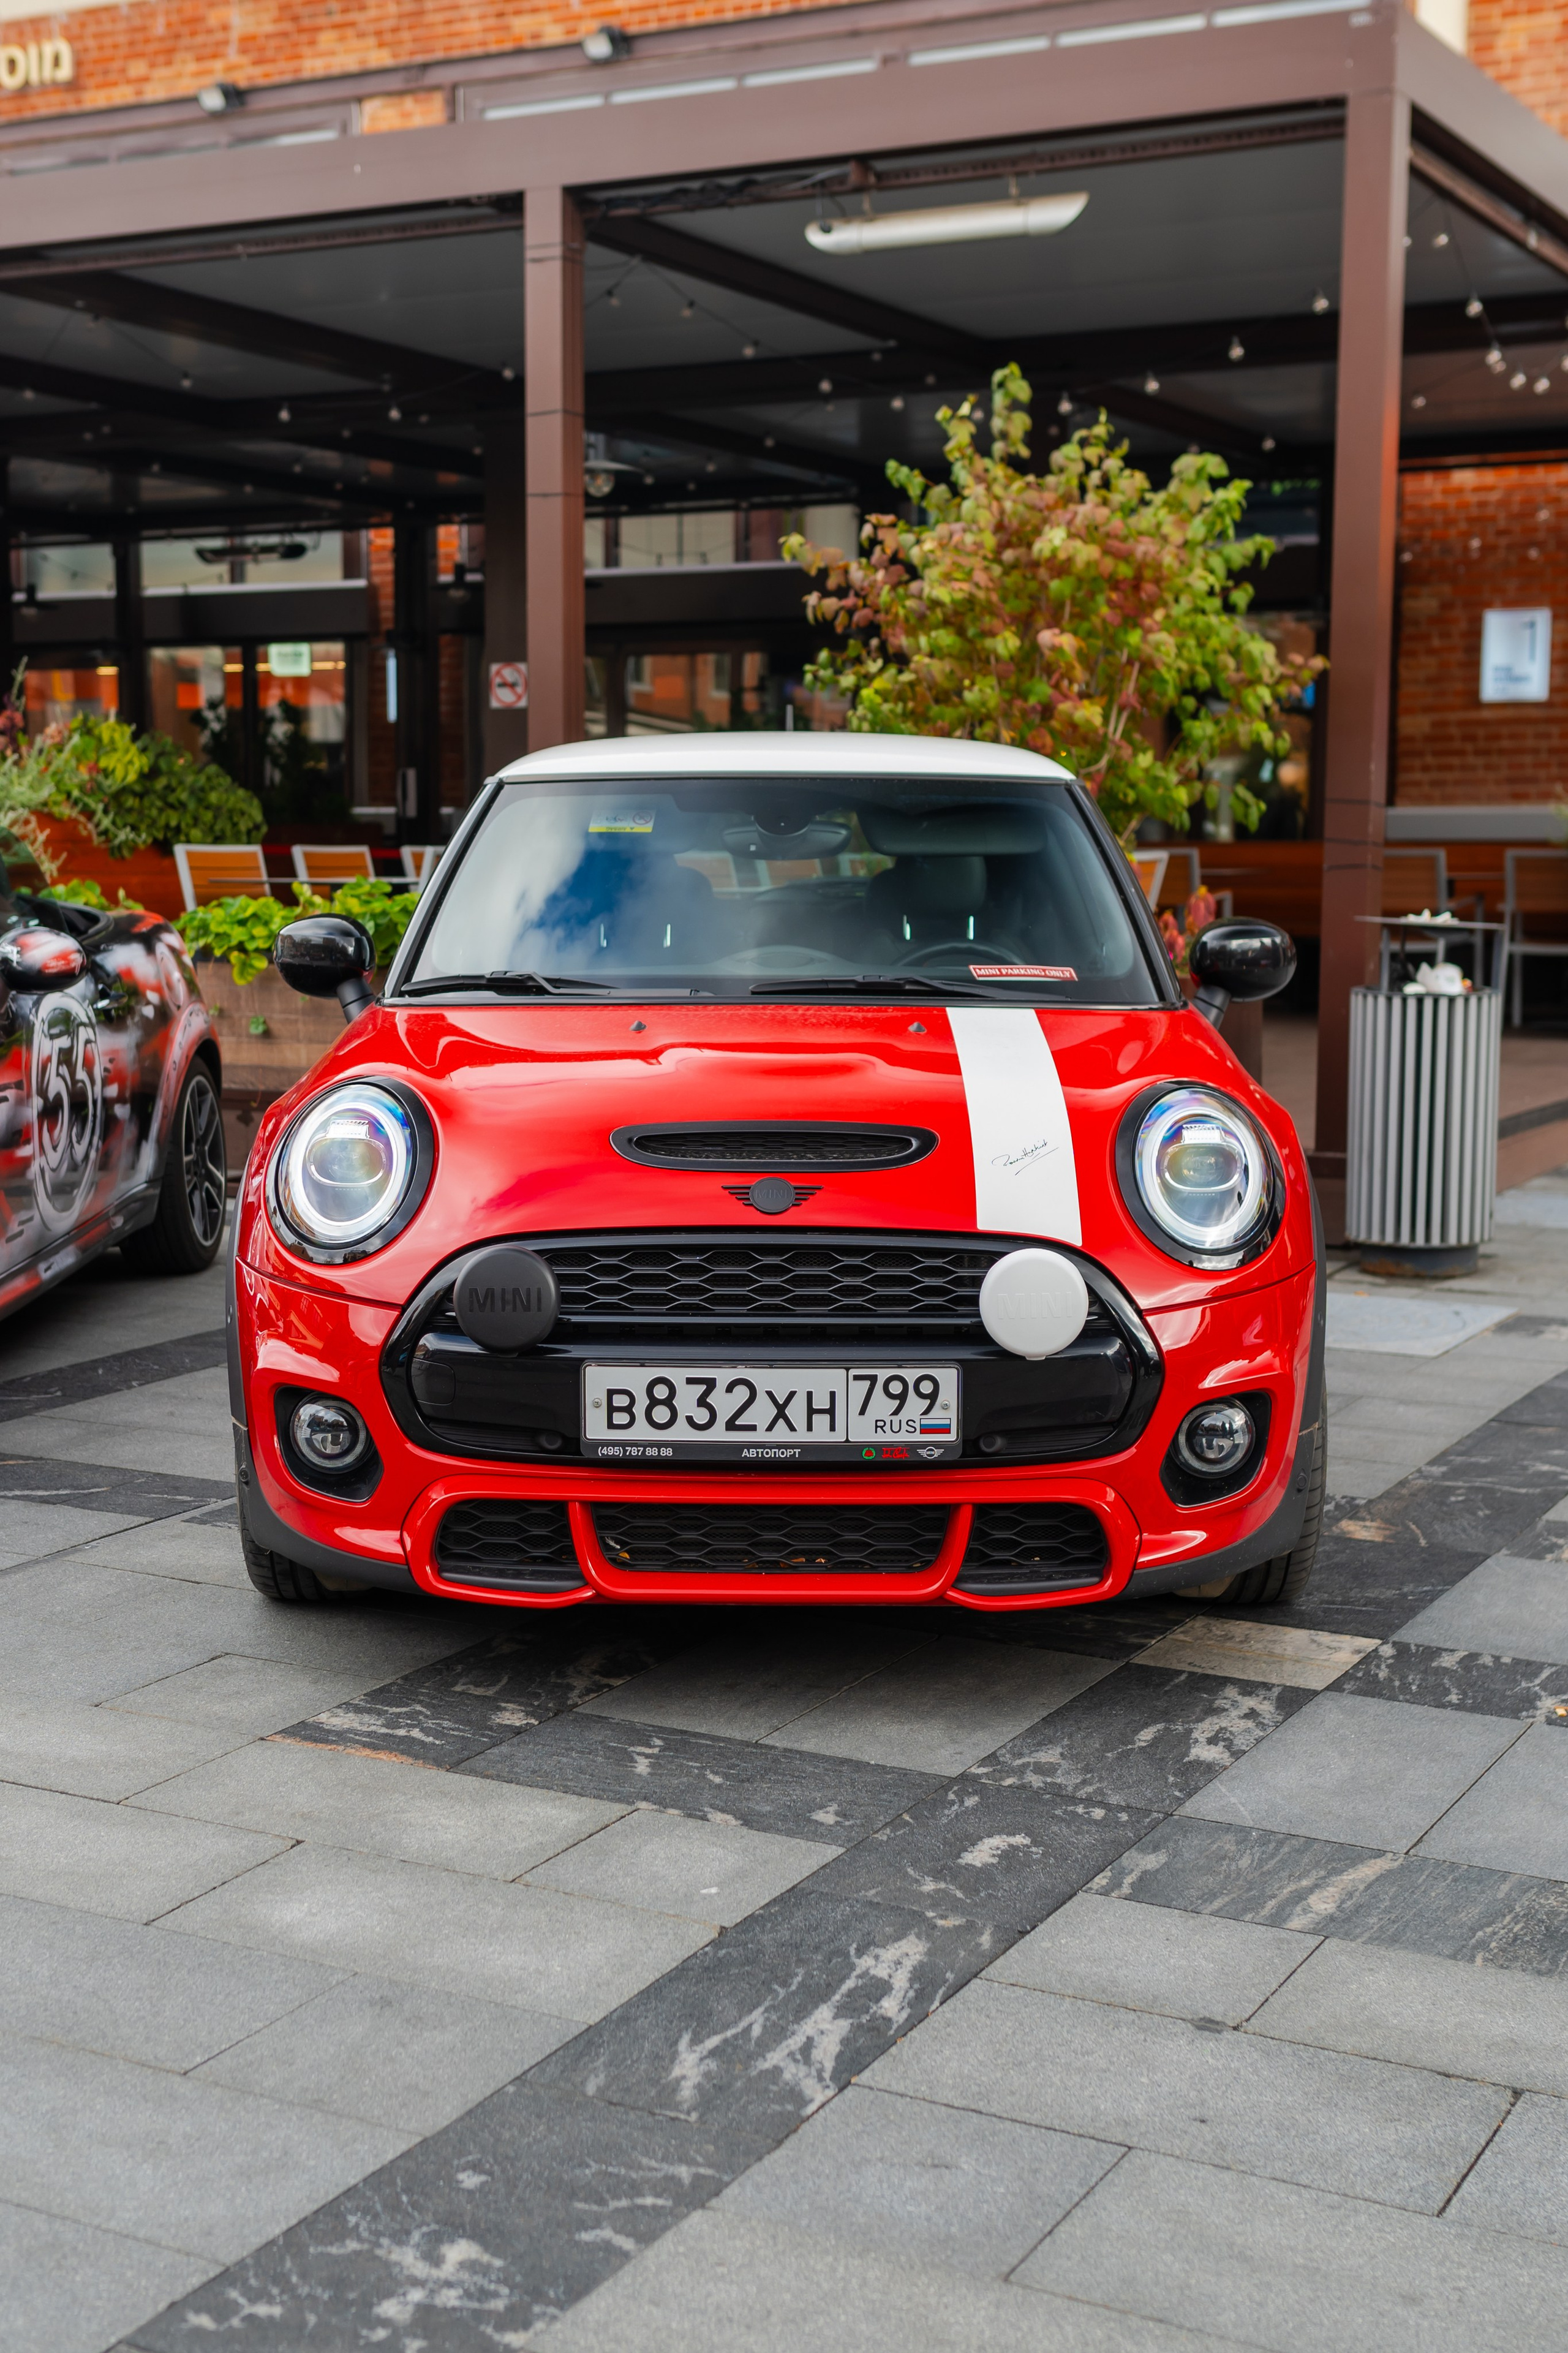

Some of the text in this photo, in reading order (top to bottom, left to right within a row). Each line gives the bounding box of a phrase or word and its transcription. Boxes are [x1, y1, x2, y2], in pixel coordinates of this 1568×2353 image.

[755, 1189, 788, 1199] MINI
[469, 1287, 543, 1313] MINI
[997, 1291, 1073, 1320] MINI
[852, 1373, 940, 1416] 799
[874, 1418, 917, 1434] RUS
[598, 1446, 673, 1457] (495) 787 88 88
[741, 1448, 801, 1458] АВТОПОРТ
